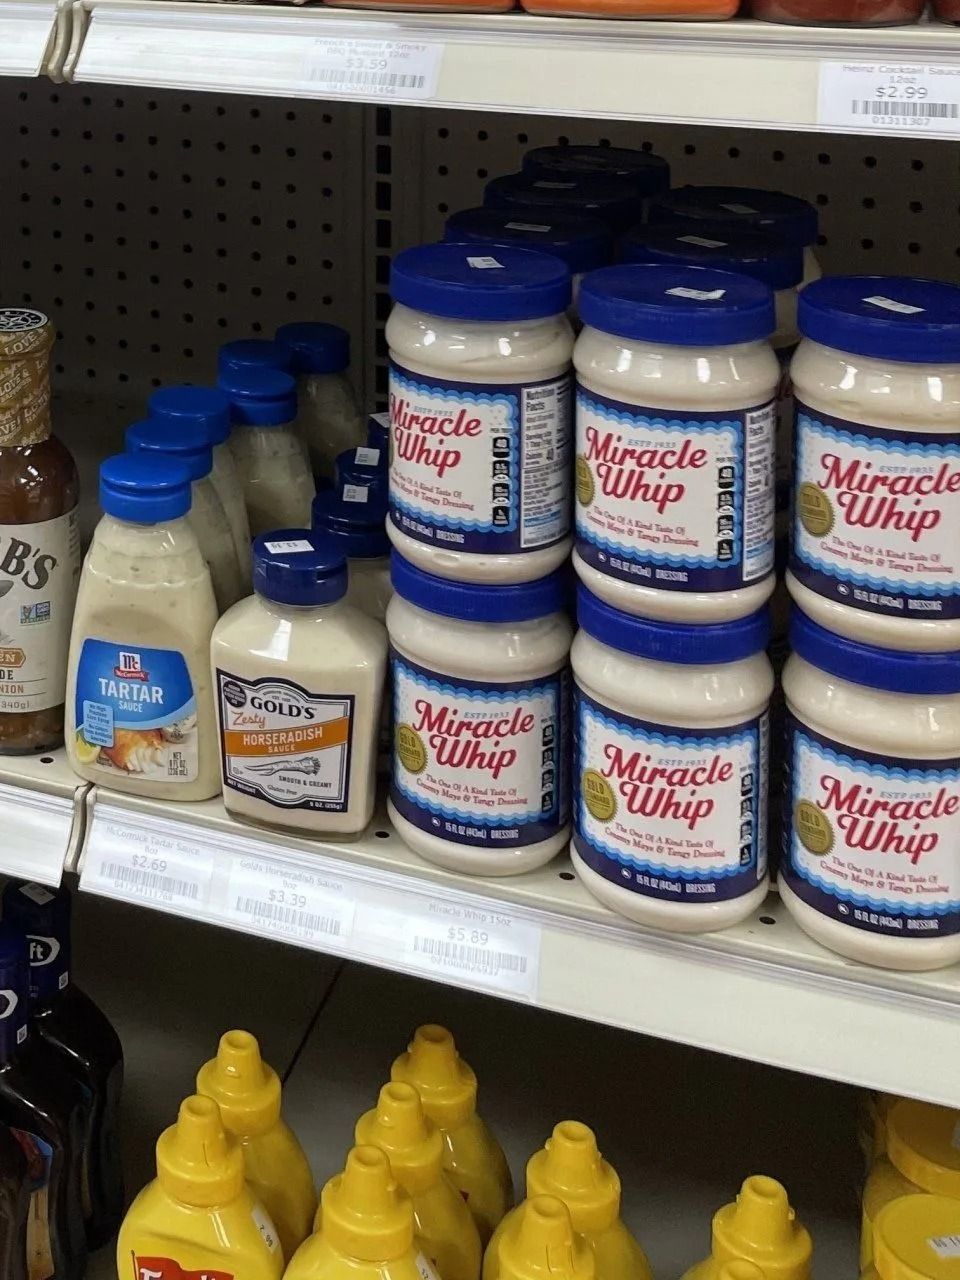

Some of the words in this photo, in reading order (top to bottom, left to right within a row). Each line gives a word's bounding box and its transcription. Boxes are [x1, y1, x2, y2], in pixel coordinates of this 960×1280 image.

[345, 59, 388, 70] $3.59
[843, 65, 874, 74] Heinz
[879, 66, 925, 75] Cocktail
[875, 86, 928, 99] $2.99
[889, 75, 917, 84] 12oz
[390, 392, 482, 437] Miracle
[396, 429, 462, 478] Whip
[584, 426, 707, 470] Miracle
[817, 453, 960, 498] Miracle
[596, 463, 686, 515] Whip
[839, 491, 943, 542] Whip
[98, 678, 164, 705] TARTAR
[119, 701, 143, 713] SAUCE
[250, 696, 316, 720] GOLD'S
[412, 698, 535, 740] Miracle
[231, 712, 266, 729] Zesty
[243, 727, 323, 747] HORSERADISH
[268, 744, 296, 754] SAUCE
[428, 734, 517, 780] Whip
[600, 742, 734, 788] Miracle
[308, 780, 332, 789] CREAMY
[816, 774, 960, 821] Miracle
[618, 780, 715, 831] Whip
[106, 824, 147, 842] McCormick
[150, 835, 175, 850] Tartar
[176, 842, 201, 856] Sauce
[836, 814, 938, 865] Whip
[131, 854, 168, 872] $2.69
[316, 877, 344, 891] Sauce
[268, 889, 307, 908] $3.39
[428, 902, 460, 918] Miracle
[462, 908, 488, 924] Whip
[489, 914, 513, 928] 15oz
[446, 926, 489, 946] $5.89
